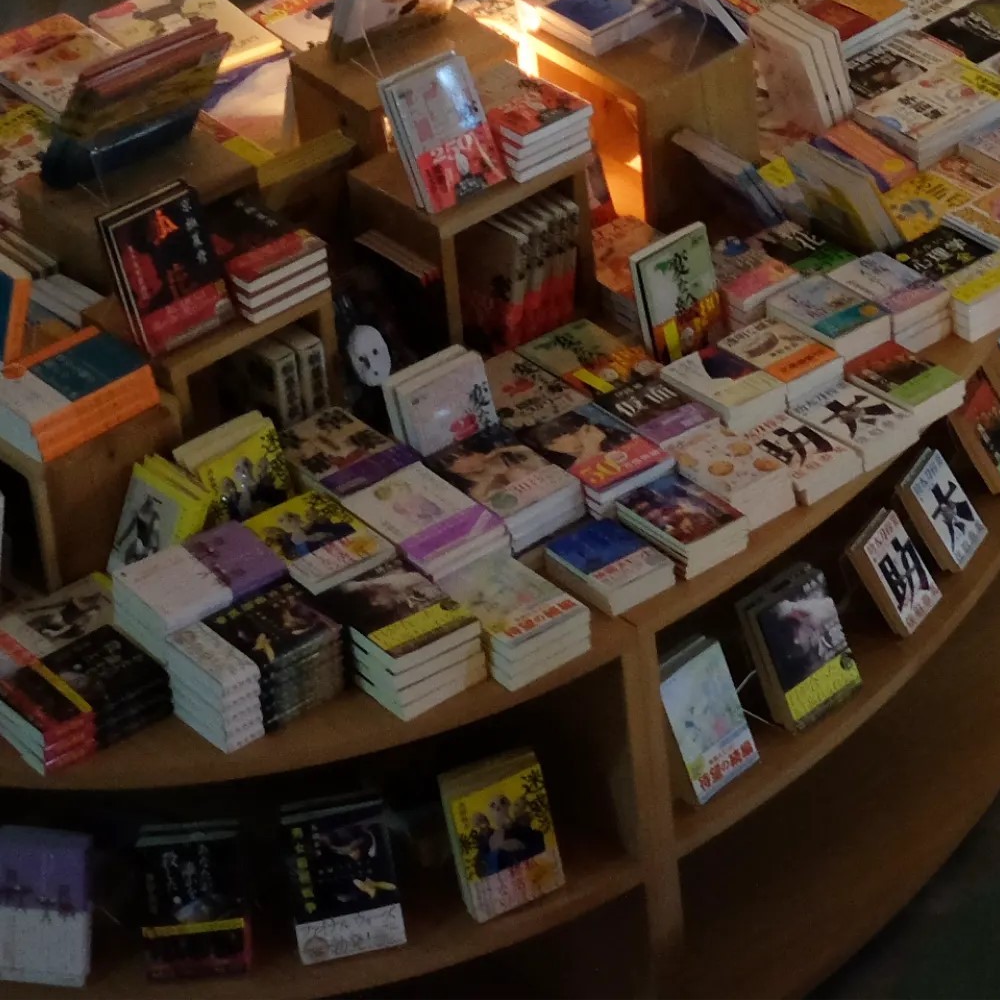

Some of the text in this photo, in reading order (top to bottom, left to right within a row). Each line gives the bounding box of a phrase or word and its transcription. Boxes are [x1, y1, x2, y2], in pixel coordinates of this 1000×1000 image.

[820, 394, 894, 440] 太
[931, 480, 975, 554] 太
[877, 537, 930, 613] 助
